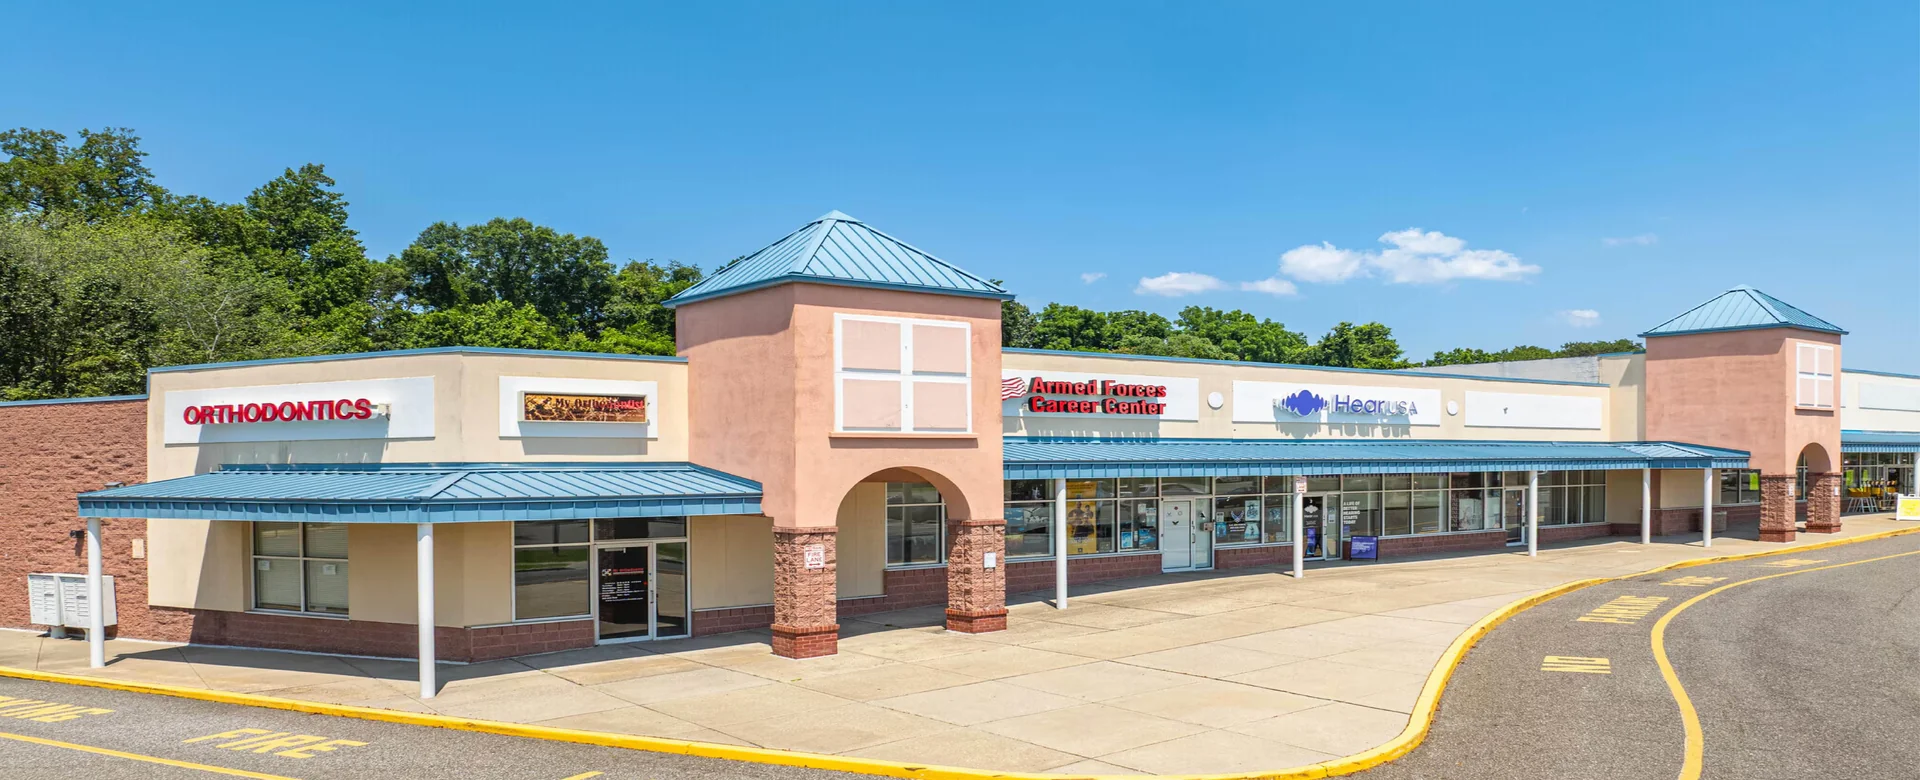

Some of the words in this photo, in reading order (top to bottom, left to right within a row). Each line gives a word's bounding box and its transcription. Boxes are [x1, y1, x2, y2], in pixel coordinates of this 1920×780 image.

[1028, 376, 1098, 396] Armed
[1102, 379, 1167, 398] Forces
[183, 398, 373, 425] ORTHODONTICS
[555, 398, 571, 409] My
[574, 398, 644, 409] Orthodontist
[1028, 396, 1099, 413] Career
[1101, 397, 1167, 415] Center
[181, 727, 371, 760] FIRE
